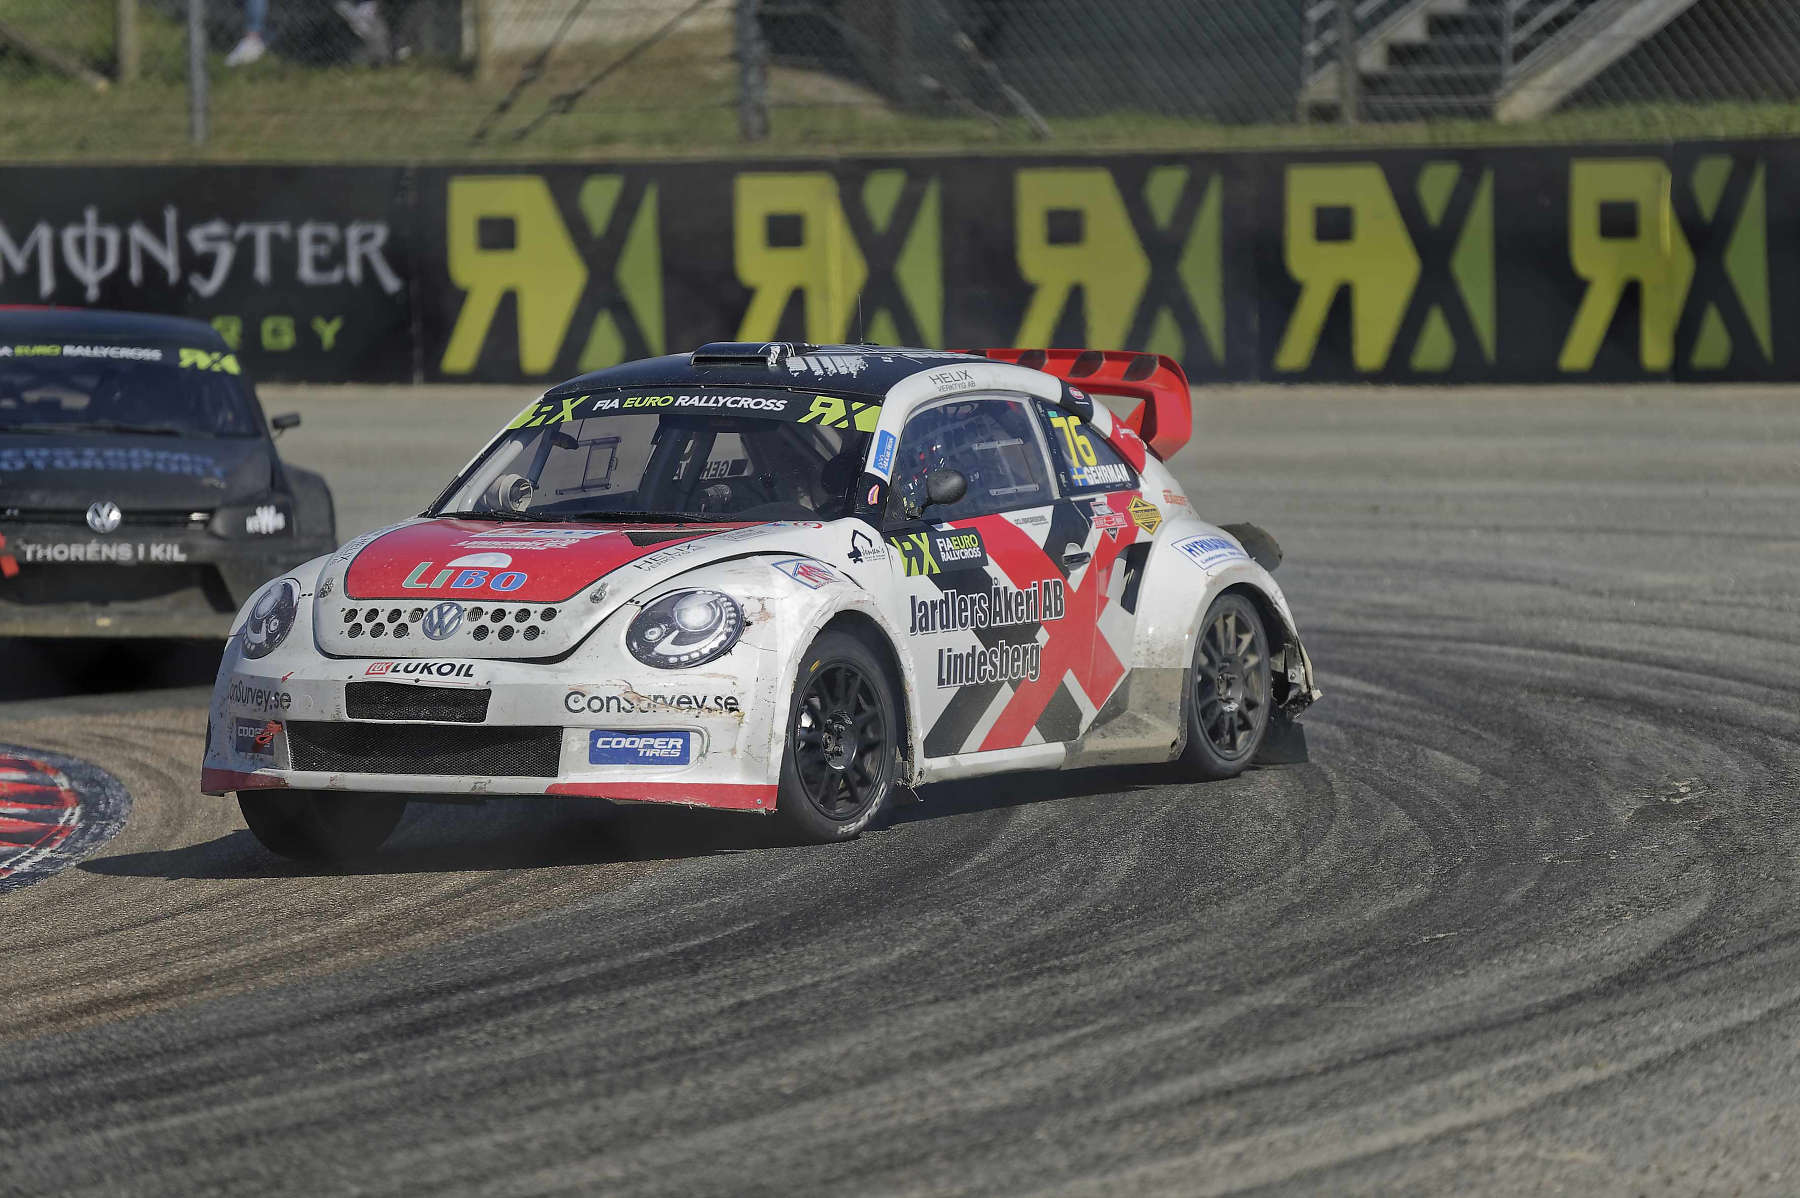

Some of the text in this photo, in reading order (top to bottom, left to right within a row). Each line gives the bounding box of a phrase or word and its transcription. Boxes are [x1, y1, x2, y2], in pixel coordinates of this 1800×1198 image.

[928, 369, 974, 385] HELIX
[592, 395, 789, 412] FIA EURO RALLYCROSS
[1049, 415, 1098, 468] 76
[150, 543, 187, 562] KIL
[941, 547, 982, 562] RALLYCROSS
[909, 577, 1065, 637] Jardlers Åkeri AB
[391, 662, 475, 678] LUKOIL
[936, 640, 1043, 689] Lindesberg
[596, 737, 684, 749] COOPER
[637, 748, 682, 758] TIRES
